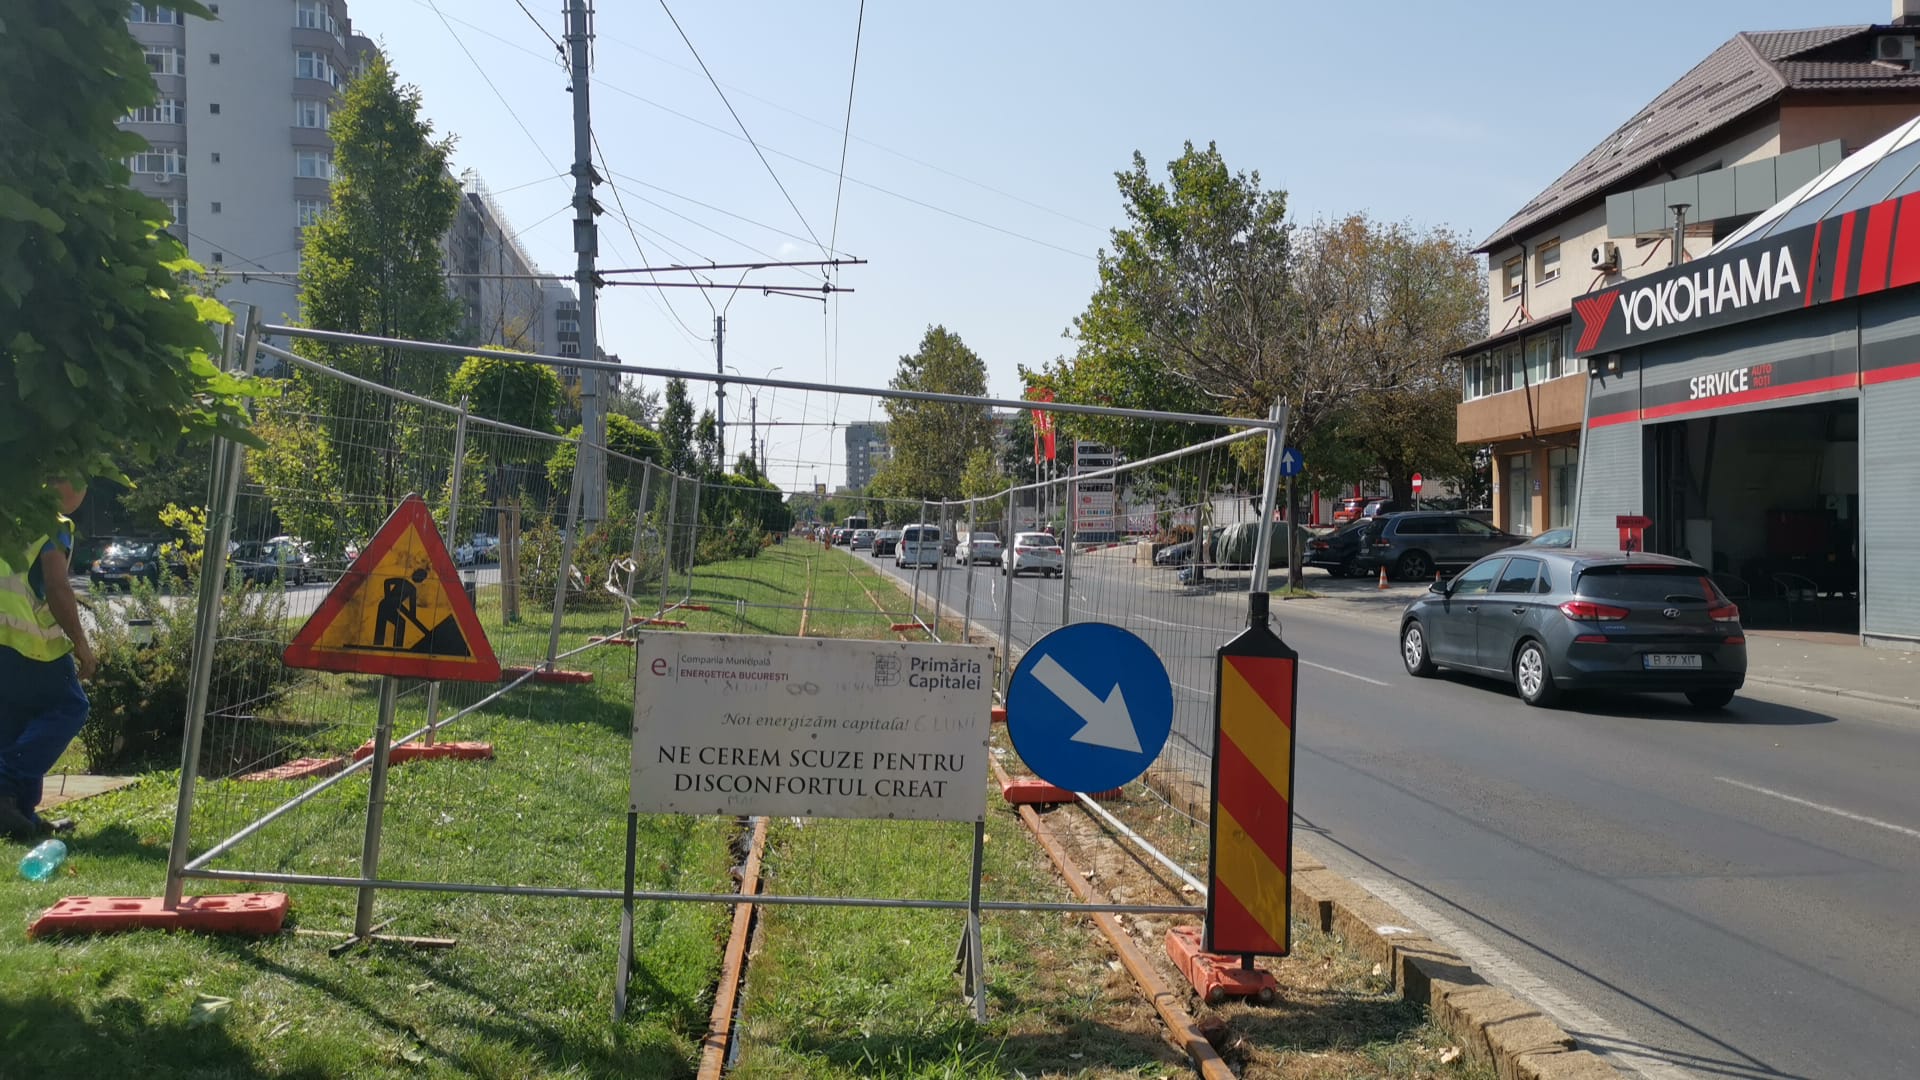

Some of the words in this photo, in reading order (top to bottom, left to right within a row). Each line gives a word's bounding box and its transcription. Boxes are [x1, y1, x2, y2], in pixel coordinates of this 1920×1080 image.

[1619, 245, 1801, 335] YOKOHAMA
[1751, 363, 1773, 377] AUTO
[1689, 367, 1749, 400] SERVICE
[911, 657, 981, 674] Primăria
[1665, 655, 1677, 665] 37
[680, 668, 737, 679] ENERGETICA
[908, 673, 981, 692] Capitalei
[657, 746, 691, 765] NE
[699, 746, 781, 767] CEREM
[789, 749, 864, 769] SCUZE
[872, 752, 965, 772] PENTRU
[674, 773, 868, 797] DISCONFORTUL
[874, 779, 948, 798] CREAT
